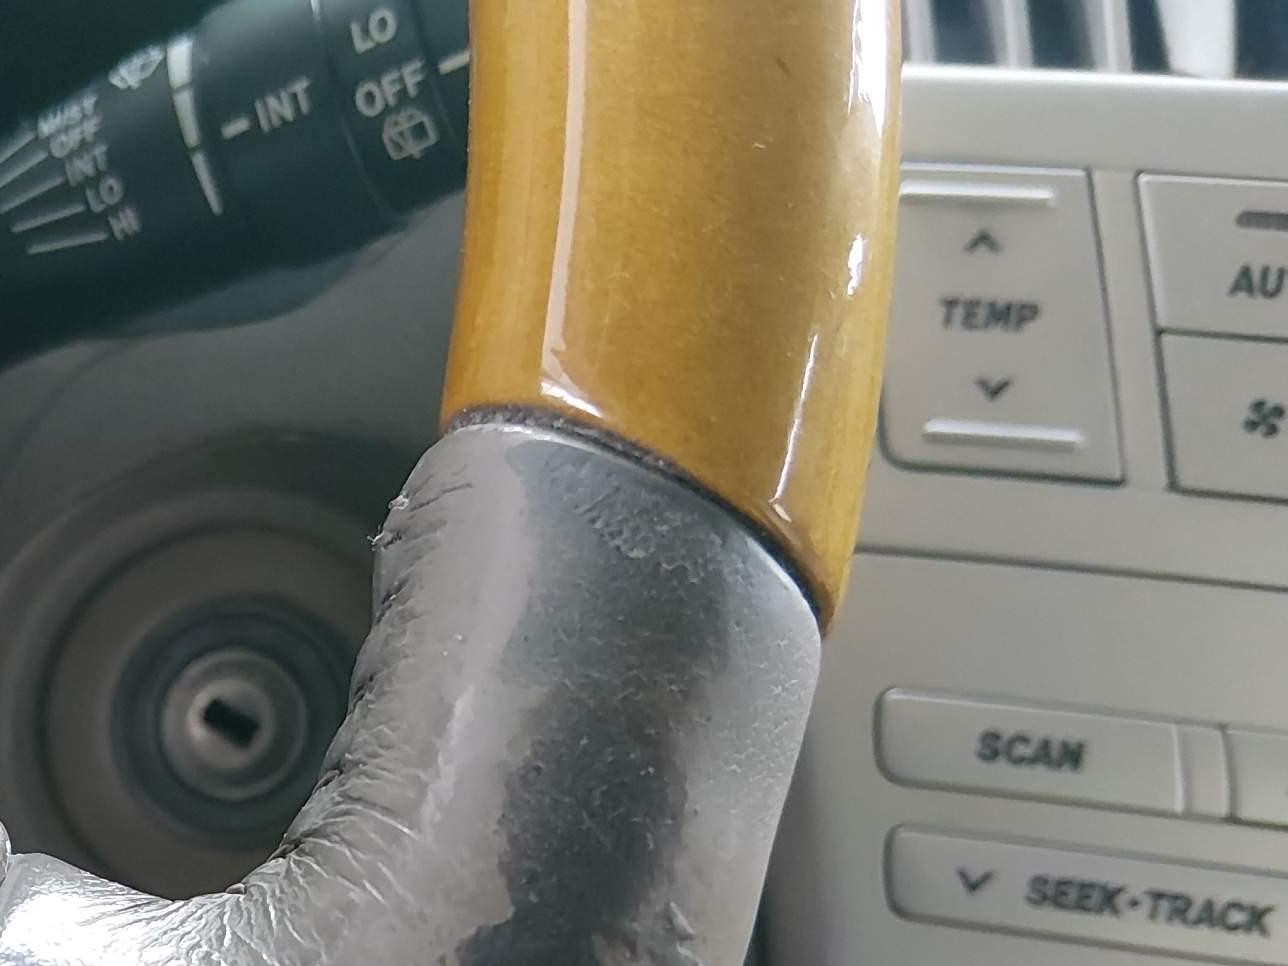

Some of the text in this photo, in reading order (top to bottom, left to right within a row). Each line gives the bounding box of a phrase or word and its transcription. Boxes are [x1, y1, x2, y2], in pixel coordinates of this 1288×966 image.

[350, 8, 397, 54] LO
[255, 76, 311, 133] INT
[355, 57, 426, 117] OFF
[65, 143, 108, 187] INT
[85, 176, 124, 213] LO
[1225, 262, 1288, 301] AU
[938, 298, 1041, 333] TEMP
[976, 729, 1087, 772] SCAN
